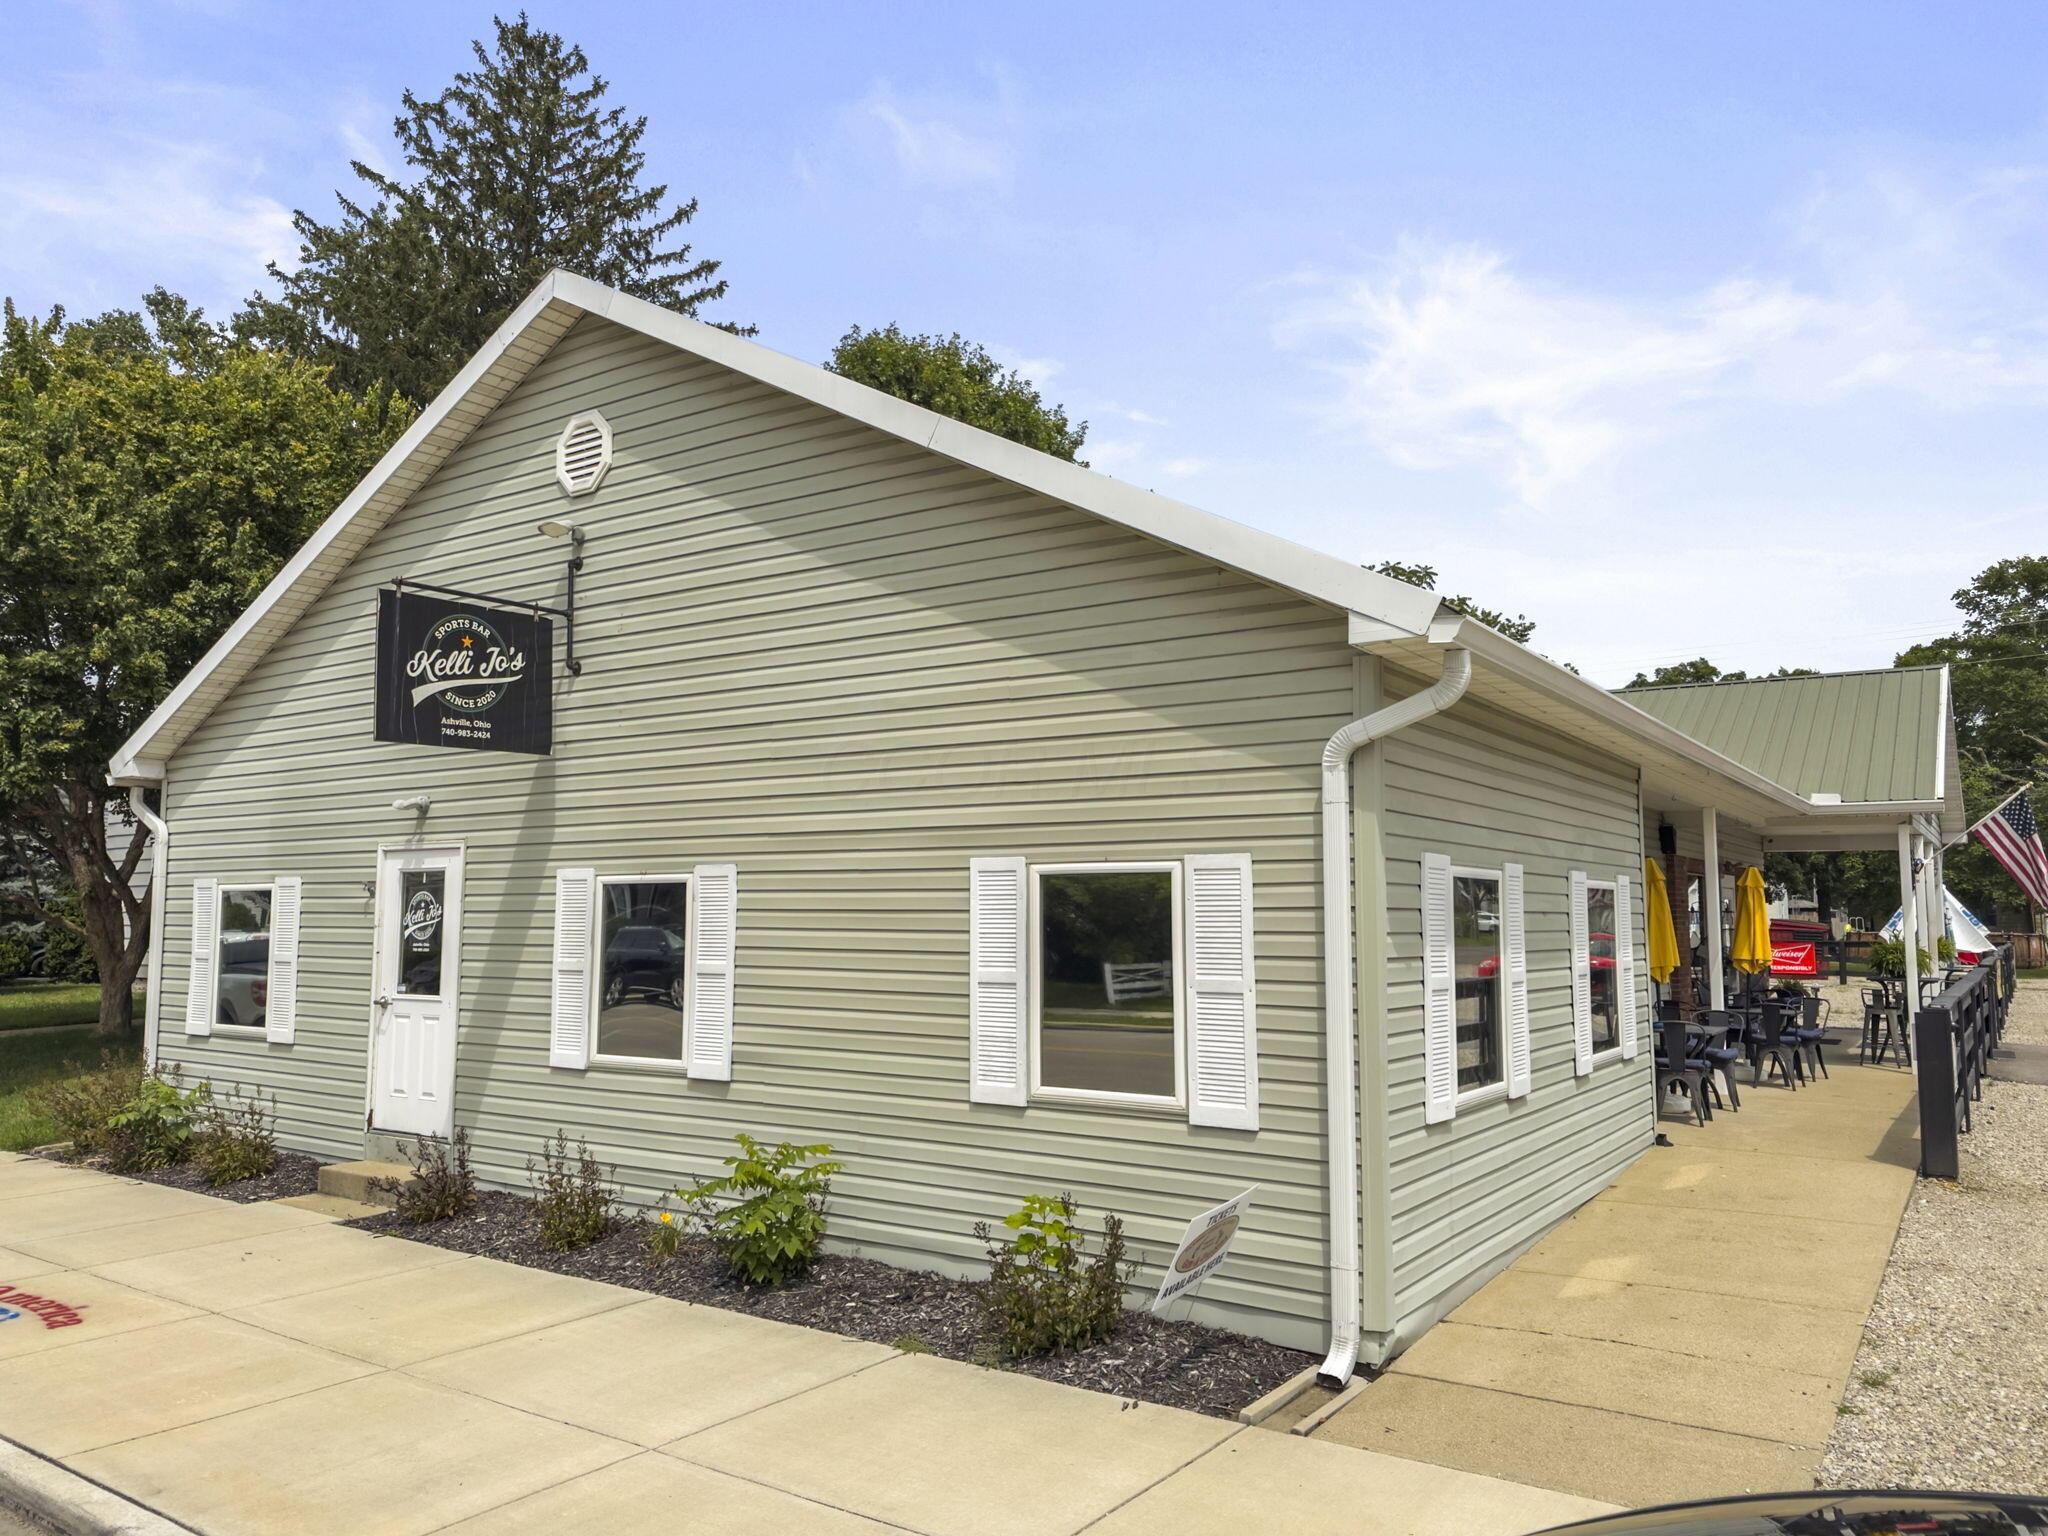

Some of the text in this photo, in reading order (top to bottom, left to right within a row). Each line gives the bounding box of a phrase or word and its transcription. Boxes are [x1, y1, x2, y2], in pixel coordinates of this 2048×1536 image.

[434, 619, 491, 640] SPORTS BAR
[406, 646, 526, 682] Kelli Jo's
[445, 690, 496, 708] SINCE 2020
[441, 716, 491, 729] Ashville, Ohio
[441, 727, 491, 739] 740-983-2424
[1160, 1264, 1205, 1300] AVAILABLE
